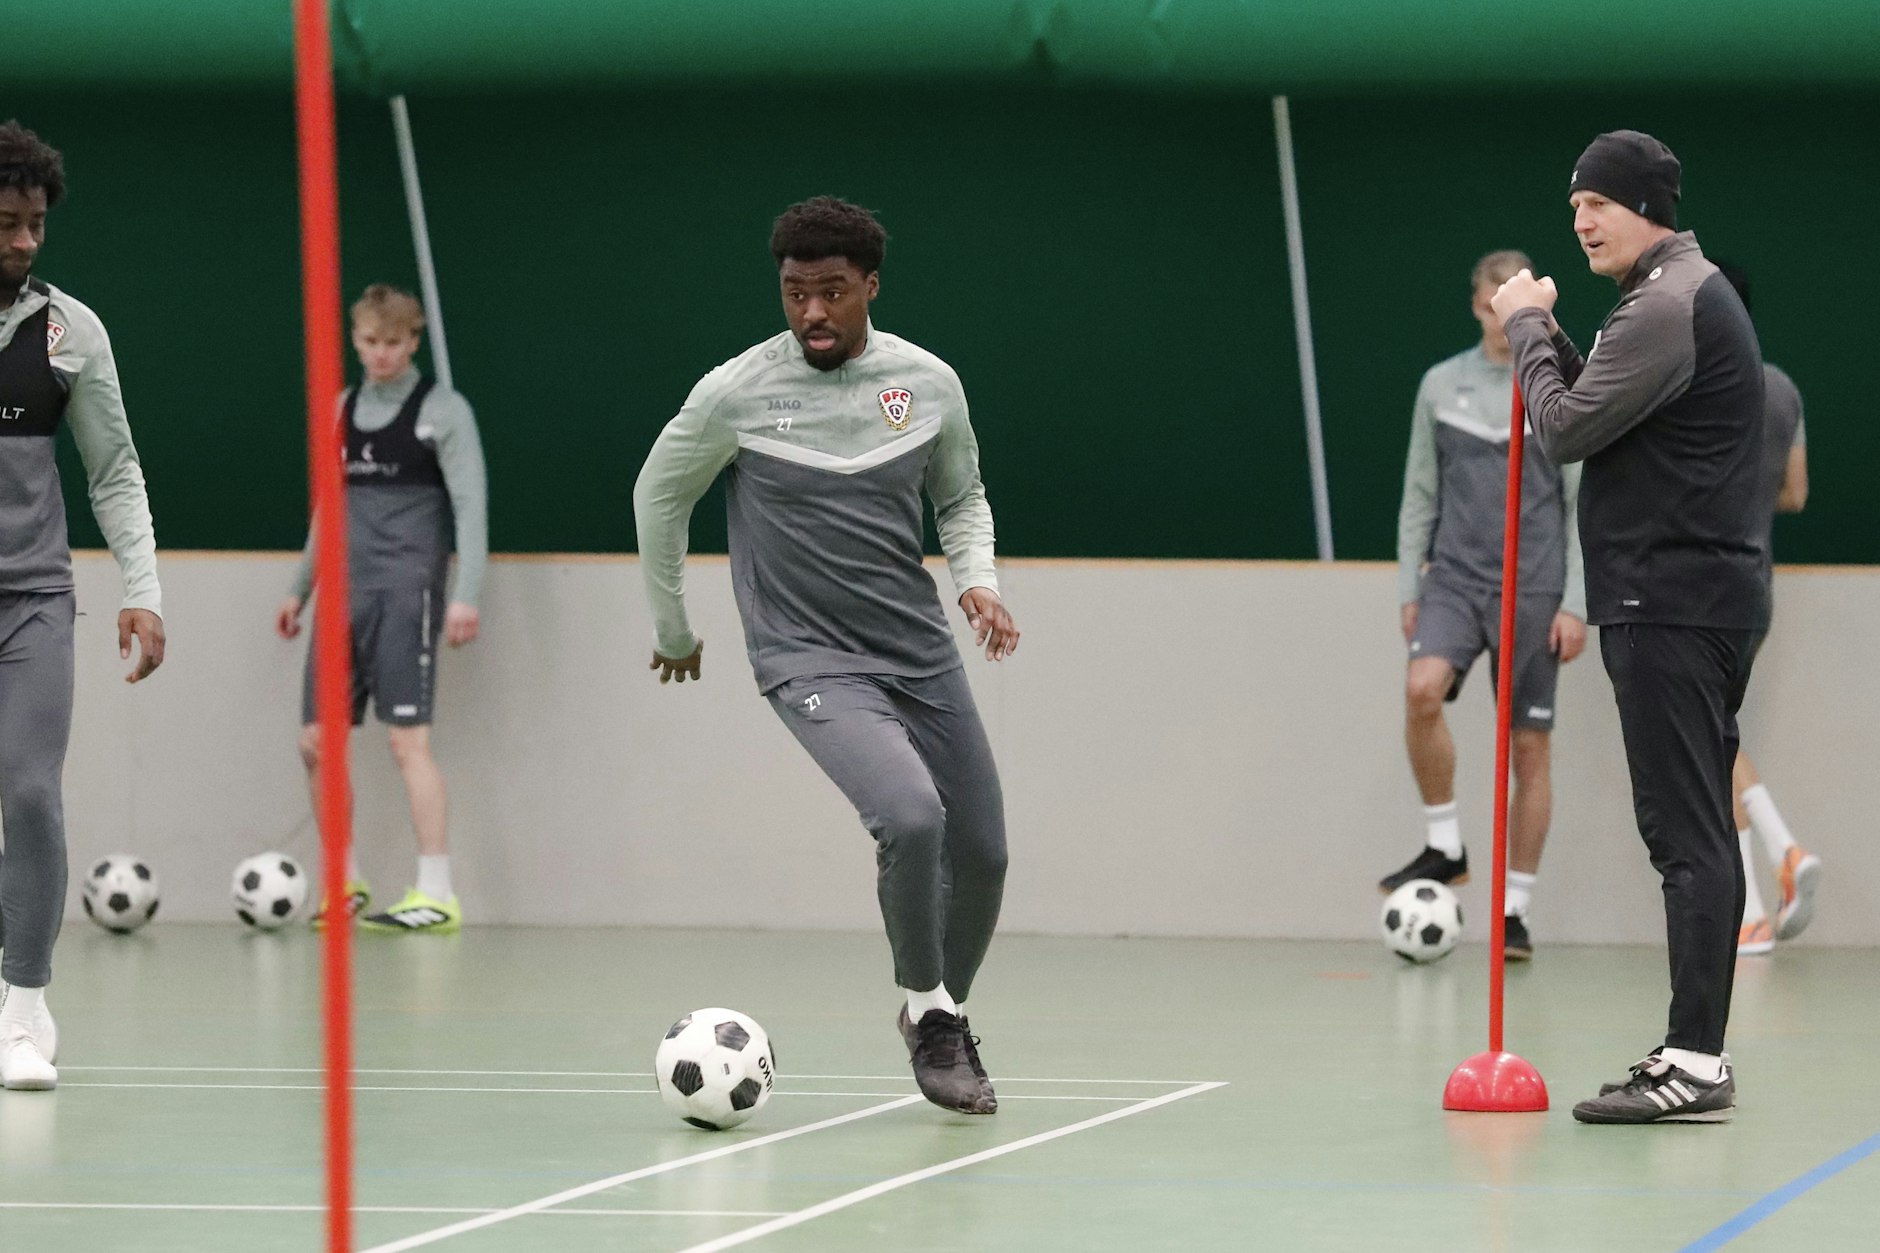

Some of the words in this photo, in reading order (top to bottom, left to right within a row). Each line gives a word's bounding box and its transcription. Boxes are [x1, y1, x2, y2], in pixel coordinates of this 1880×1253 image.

[882, 391, 909, 404] BFC
[767, 400, 801, 411] JAKO
[776, 417, 793, 431] 27
[804, 693, 821, 711] 27
